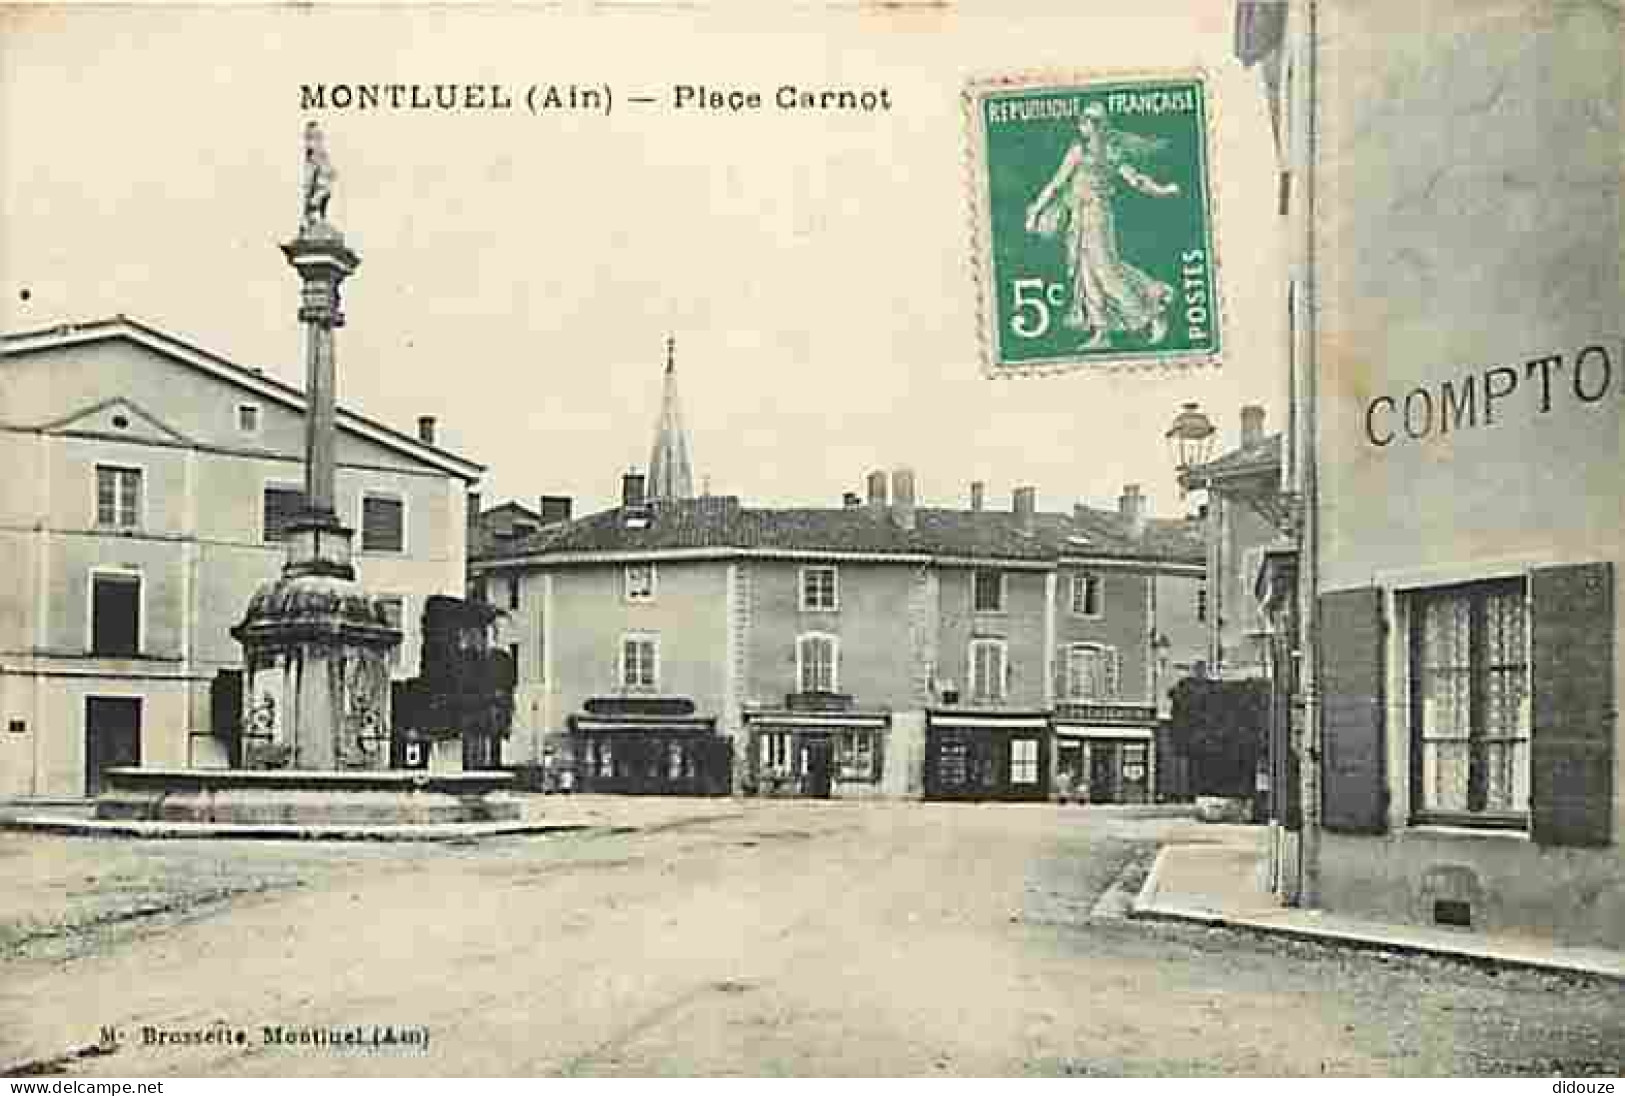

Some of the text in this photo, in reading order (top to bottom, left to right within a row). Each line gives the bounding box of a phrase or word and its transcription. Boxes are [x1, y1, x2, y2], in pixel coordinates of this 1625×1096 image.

[300, 84, 511, 110] MONTLUEL
[527, 85, 612, 116] (Ain)
[775, 86, 891, 111] Carnot
[1183, 249, 1206, 340] POSTES
[1366, 345, 1625, 447] COMPTO
